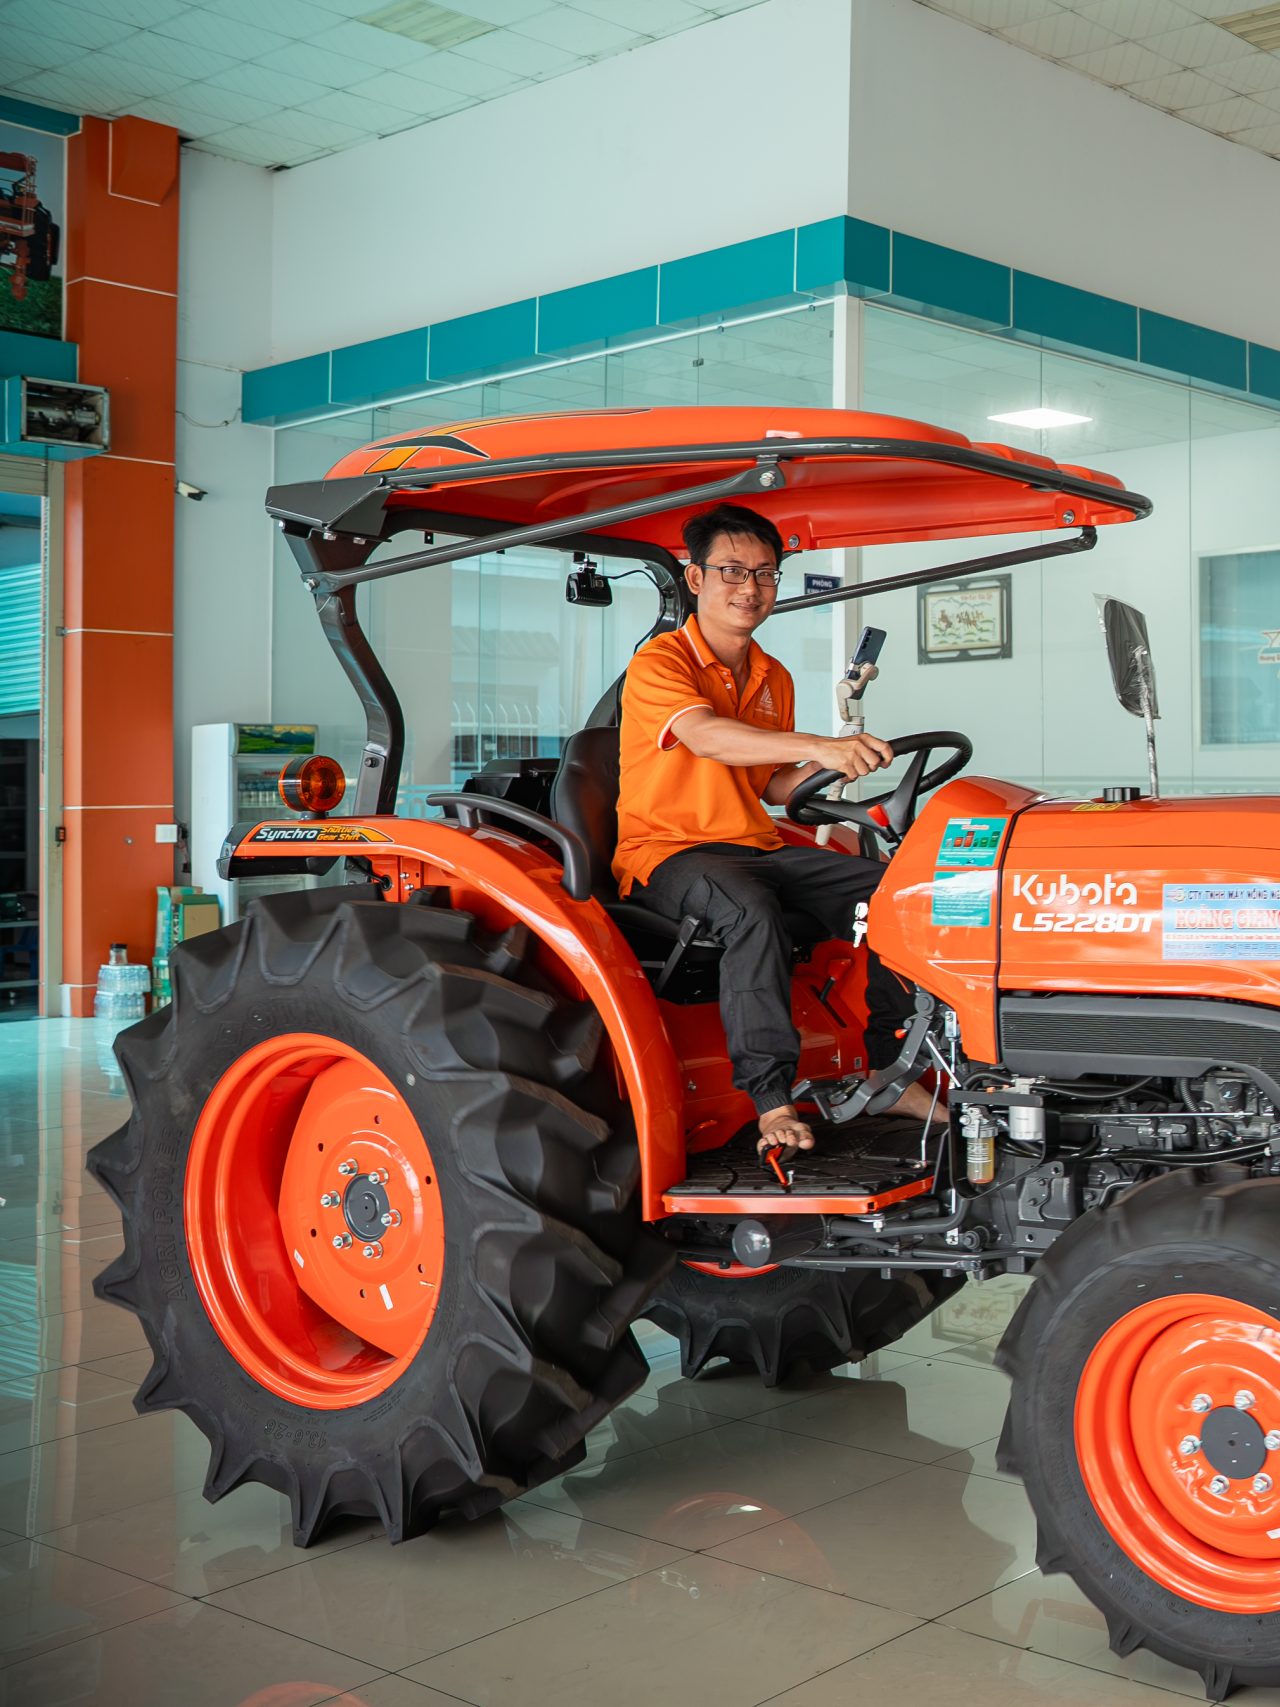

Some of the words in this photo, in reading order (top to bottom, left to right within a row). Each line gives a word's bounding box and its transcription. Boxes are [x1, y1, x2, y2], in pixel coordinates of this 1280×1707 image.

[256, 828, 318, 842] Synchro
[317, 833, 338, 841] Gear
[338, 833, 361, 841] Shift
[1012, 873, 1138, 906] Kubota
[1187, 890, 1202, 900] CTY
[1205, 890, 1225, 900] TNHH
[1228, 888, 1245, 900] MÁY
[1012, 912, 1160, 933] L5228DT
[1175, 904, 1234, 930] HOÀNG
